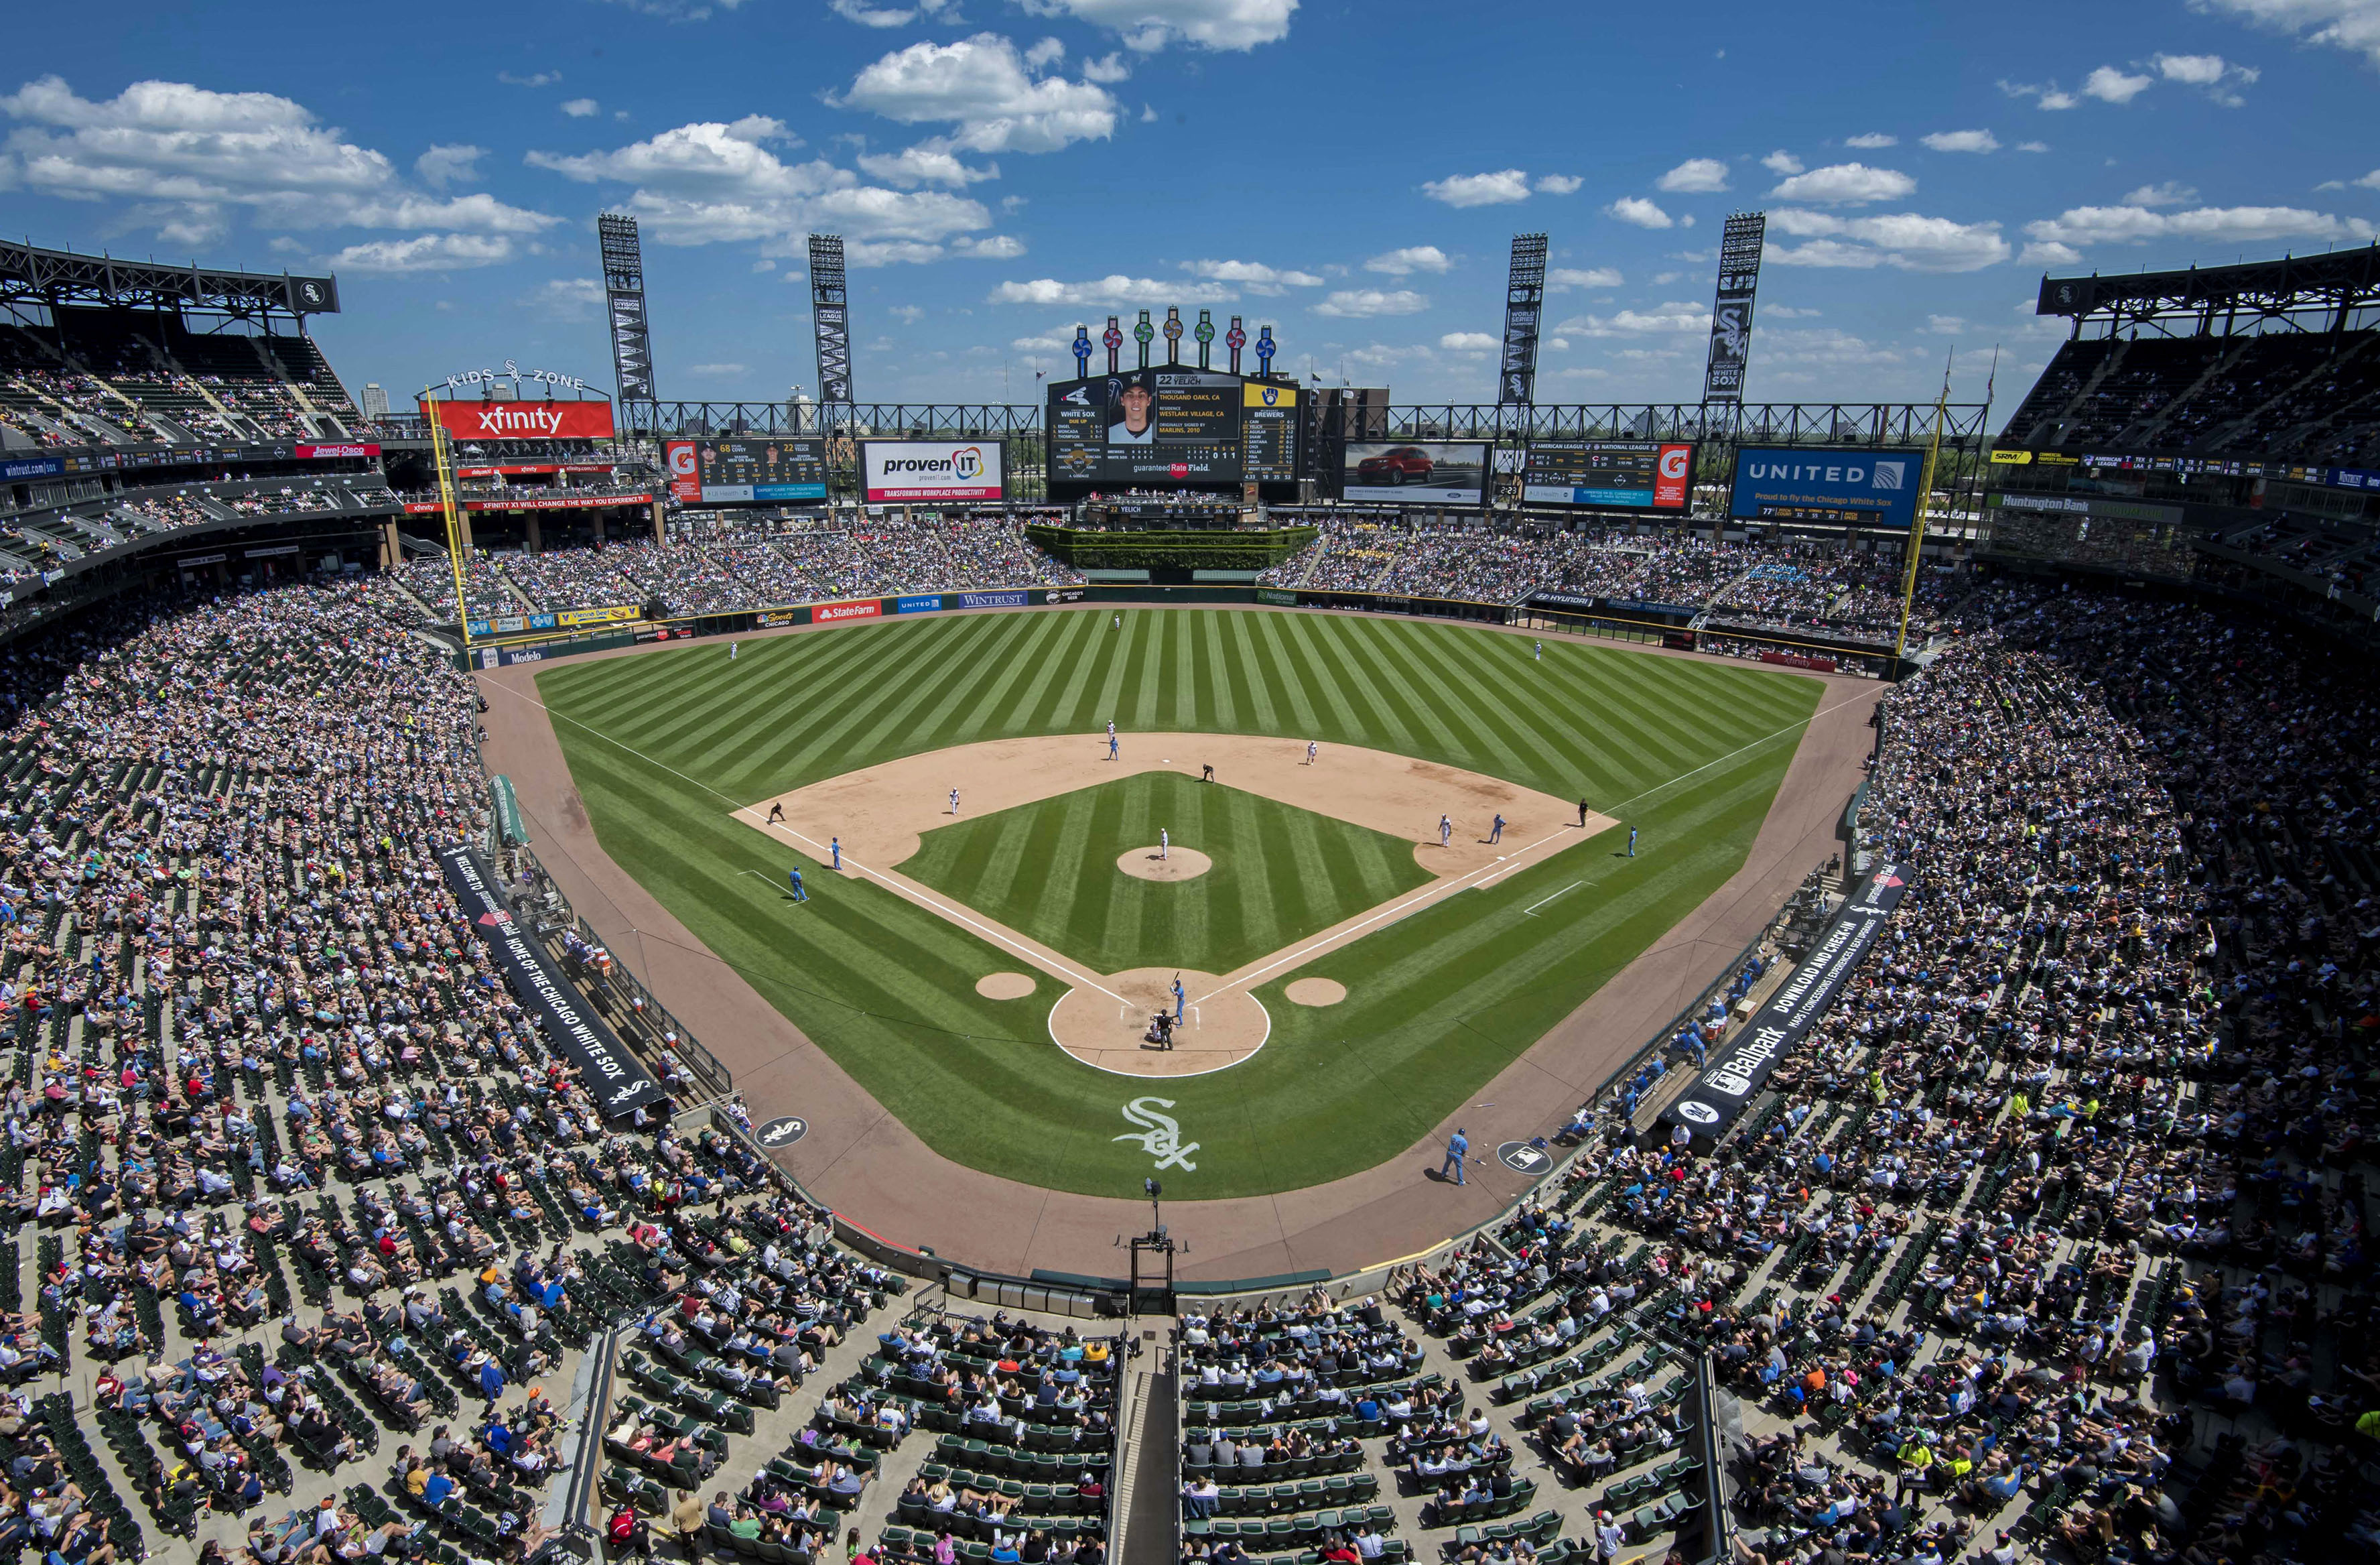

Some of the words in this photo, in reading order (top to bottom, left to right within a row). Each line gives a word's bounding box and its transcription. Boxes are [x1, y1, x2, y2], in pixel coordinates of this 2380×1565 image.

[446, 369, 494, 389] KIDS
[533, 369, 585, 391] ZONE
[1159, 376, 1172, 385] 22
[1712, 376, 1737, 385] SOX
[477, 407, 563, 435] xfinity
[314, 446, 365, 454] Jewel-Osco
[720, 444, 730, 452] 68
[5, 461, 57, 477] wintrust.com/sox
[883, 458, 951, 475] proven
[960, 456, 976, 471] IT
[1134, 464, 1170, 473] guaranteed
[1749, 464, 1865, 483] UNITED
[884, 489, 921, 497] TRANSFORMING
[1789, 494, 1800, 503] fly
[1802, 495, 1815, 503] the
[1816, 495, 1848, 505] Chicago
[1850, 497, 1873, 505] White
[413, 503, 435, 512] xfinity
[2002, 495, 2063, 511] Huntington
[2063, 498, 2089, 512] Bank
[964, 594, 1022, 605] WINTRUST
[1266, 591, 1296, 601] National
[1550, 594, 1589, 604] HYUNDAI
[1660, 606, 1694, 615] RELIEVERS
[768, 613, 793, 623] Sports
[637, 632, 658, 640] guaranteed
[511, 651, 541, 664] Modelo
[1784, 657, 1812, 668] xfinity
[454, 855, 480, 883] WELCOME
[469, 881, 484, 891] TO
[492, 910, 507, 923] Rate
[499, 920, 521, 936] Field
[505, 938, 531, 961] HOME
[520, 957, 539, 971] OF
[1772, 967, 1820, 1013] DOWNLOAD
[1810, 952, 1833, 969] AND
[1823, 921, 1857, 953] CHECK-IN
[529, 970, 551, 988] THE
[1788, 1013, 1807, 1028] MAPS
[1802, 979, 1833, 1012] CONCESSIONS
[1827, 950, 1854, 979] EXPERIENCES
[1850, 937, 1864, 948] SEAT
[1857, 919, 1877, 940] UPGRADES
[540, 983, 580, 1025] CHICAGO
[571, 1023, 606, 1057] WHITE
[1722, 1026, 1787, 1078] Ballpark
[596, 1056, 626, 1080] SOX
[722, 1293, 730, 1304] 7
[1638, 1394, 1648, 1407] 13
[500, 1519, 511, 1535] 12
[74, 1534, 81, 1548] 8
